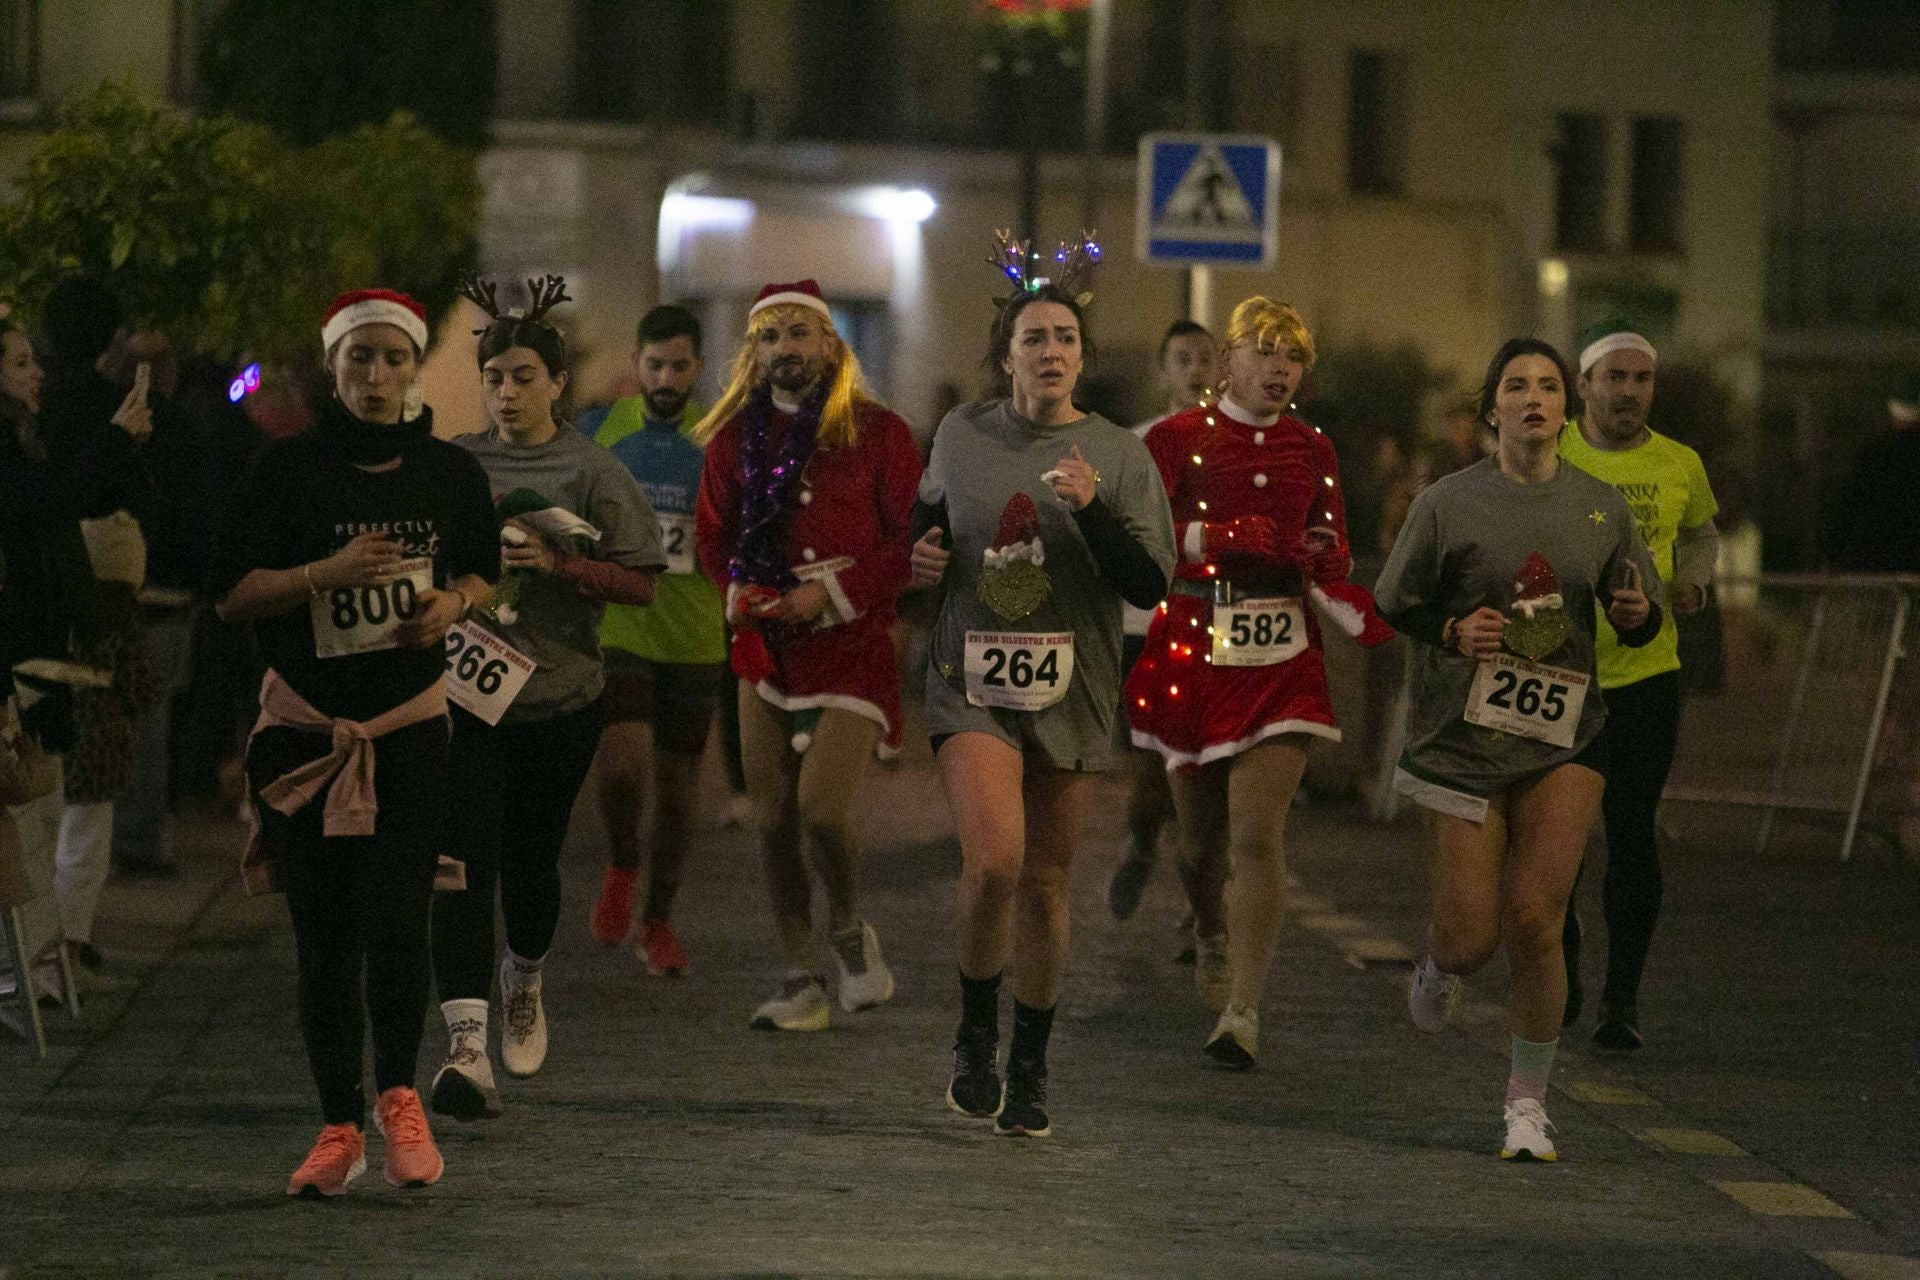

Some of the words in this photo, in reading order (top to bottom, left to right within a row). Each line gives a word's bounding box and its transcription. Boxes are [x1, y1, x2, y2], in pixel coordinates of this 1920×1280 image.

[335, 520, 433, 536] PERFECTLY
[331, 578, 417, 630] 800
[467, 625, 505, 653] SILVESTRE
[504, 650, 533, 673] MERIDA
[984, 634, 999, 644] SAN
[1001, 635, 1044, 646] SILVESTRE
[1230, 612, 1292, 647] 582
[446, 631, 509, 695] 266
[983, 648, 1059, 688] 264
[1486, 670, 1569, 721] 265
